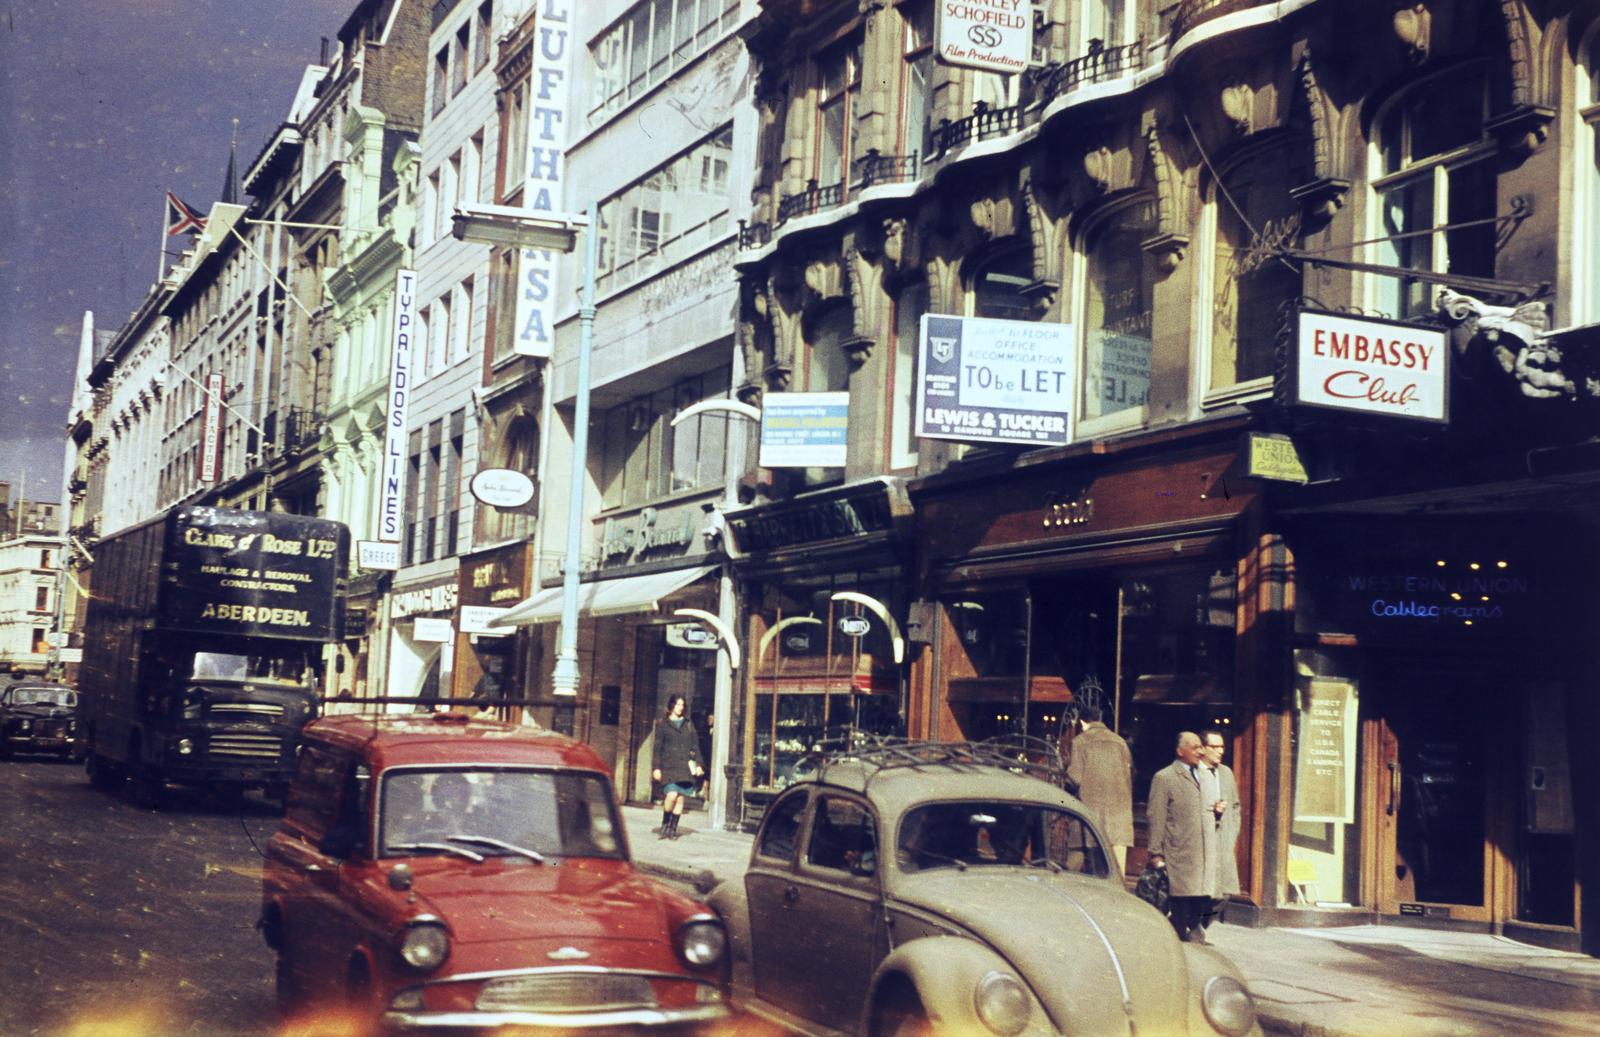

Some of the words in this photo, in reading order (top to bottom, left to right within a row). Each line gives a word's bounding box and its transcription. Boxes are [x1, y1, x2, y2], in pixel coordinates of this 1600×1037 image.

[946, 3, 1026, 29] SCHOFIELD
[945, 43, 966, 57] Film
[968, 48, 1024, 67] Productions
[994, 339, 1036, 351] OFFICE
[1022, 328, 1060, 340] FLOOR
[392, 275, 413, 428] TYPALDOS
[967, 350, 1064, 364] ACCOMMODATION
[1313, 329, 1434, 371] EMBASSY
[964, 364, 993, 389] TO
[994, 373, 1015, 391] be
[1020, 368, 1067, 394] LET
[1323, 369, 1420, 406] Club
[925, 408, 980, 427] LEWIS
[981, 412, 996, 428] &
[998, 414, 1065, 432] TUCKER
[1255, 439, 1293, 454] WESTE
[384, 438, 401, 534] LINES
[184, 528, 236, 549] CLARK
[260, 533, 303, 556] ROSE
[201, 565, 249, 577] HAULAGE
[264, 570, 313, 583] REMOVAL
[1347, 575, 1448, 592] WESTERN
[1456, 576, 1528, 593] UNION
[1310, 719, 1342, 727] SERVICE
[1321, 729, 1332, 737] TO
